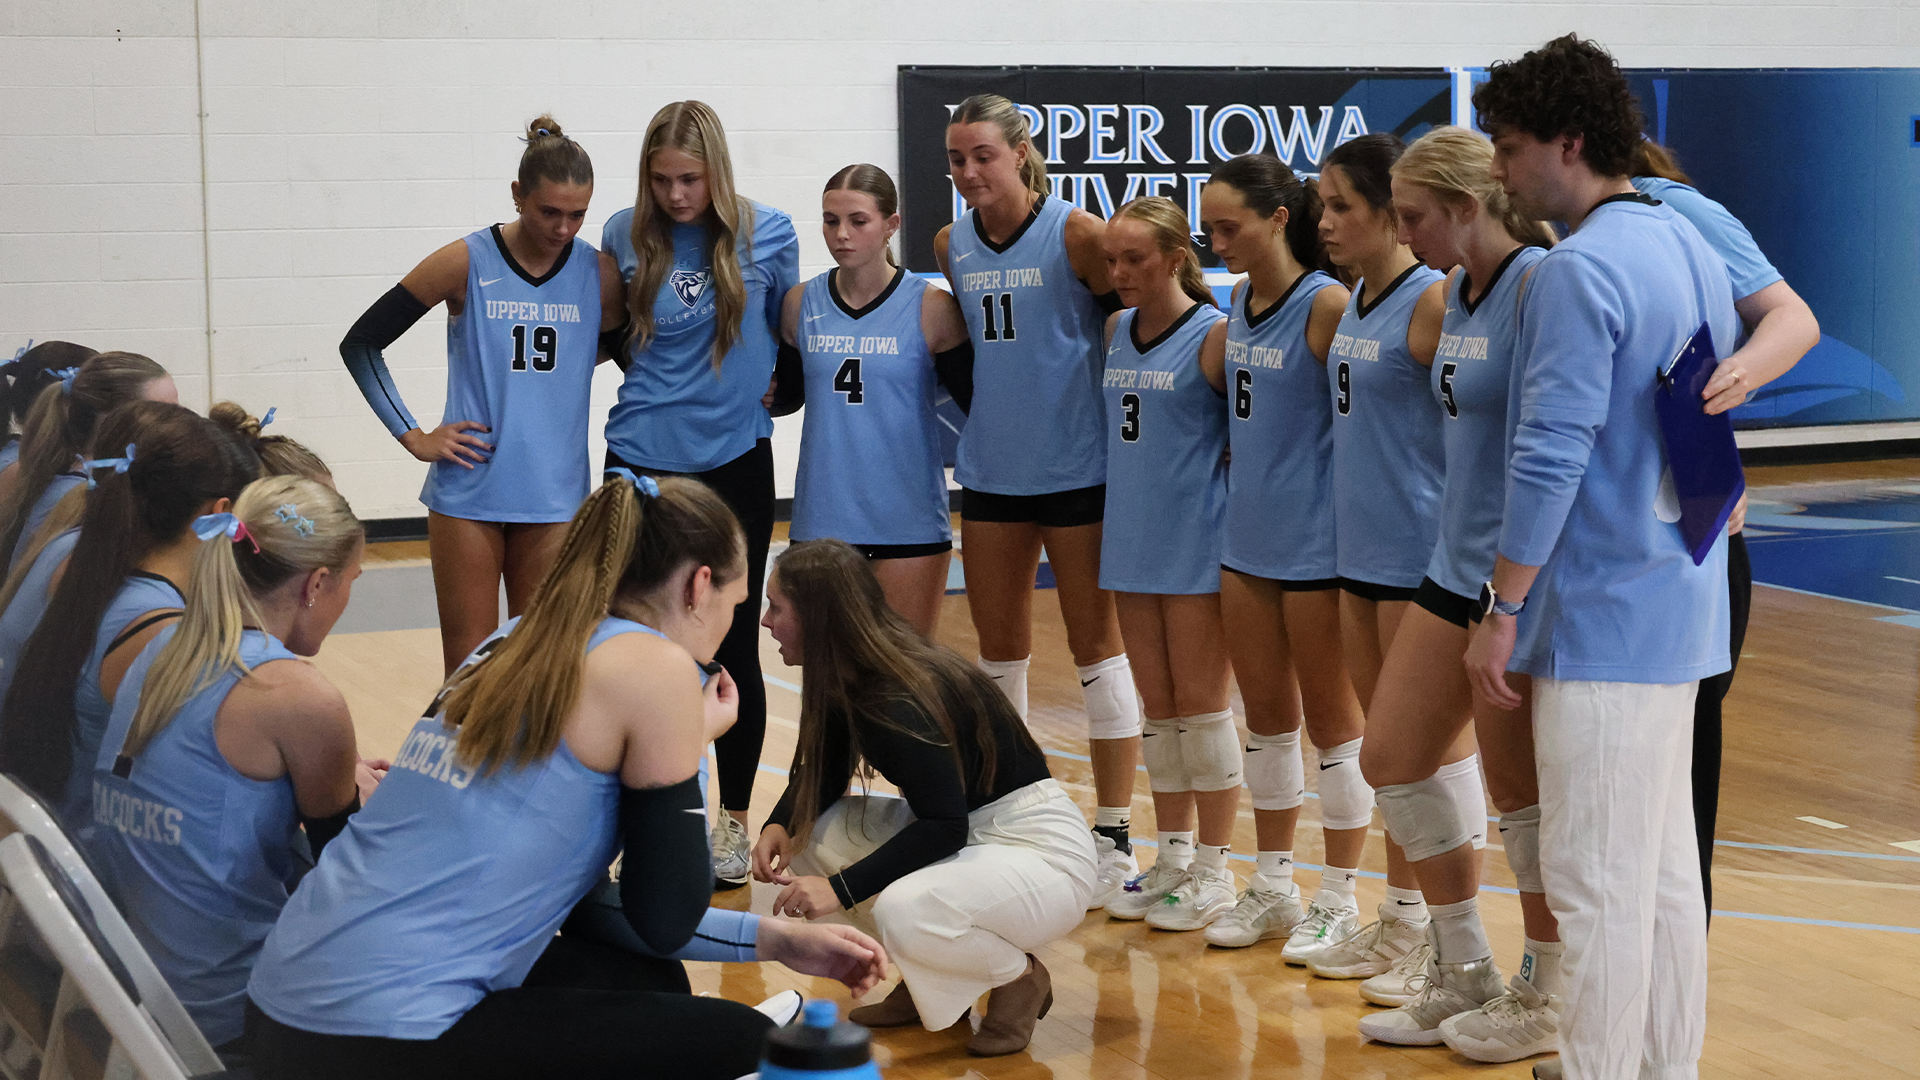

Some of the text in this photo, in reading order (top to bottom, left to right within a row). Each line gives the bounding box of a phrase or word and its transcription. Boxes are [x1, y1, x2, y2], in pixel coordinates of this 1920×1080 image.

[1185, 103, 1370, 167] IOWA
[962, 268, 1044, 292] UPPER IOWA
[486, 300, 580, 322] UPPER IOWA
[654, 303, 716, 325] OLLEYBA
[981, 291, 1016, 342] 11
[511, 324, 558, 373] 19
[807, 335, 899, 355] UPPER IOWA
[1225, 338, 1283, 369] PPER IOWA
[1329, 332, 1381, 362] PPER IOWA
[1457, 336, 1489, 360] IOWA
[833, 357, 864, 405] 4
[1138, 370, 1175, 391] IOWA
[1234, 367, 1252, 421] 6
[1337, 360, 1352, 417] 9
[1439, 361, 1458, 419] 5
[1120, 392, 1141, 443] 3
